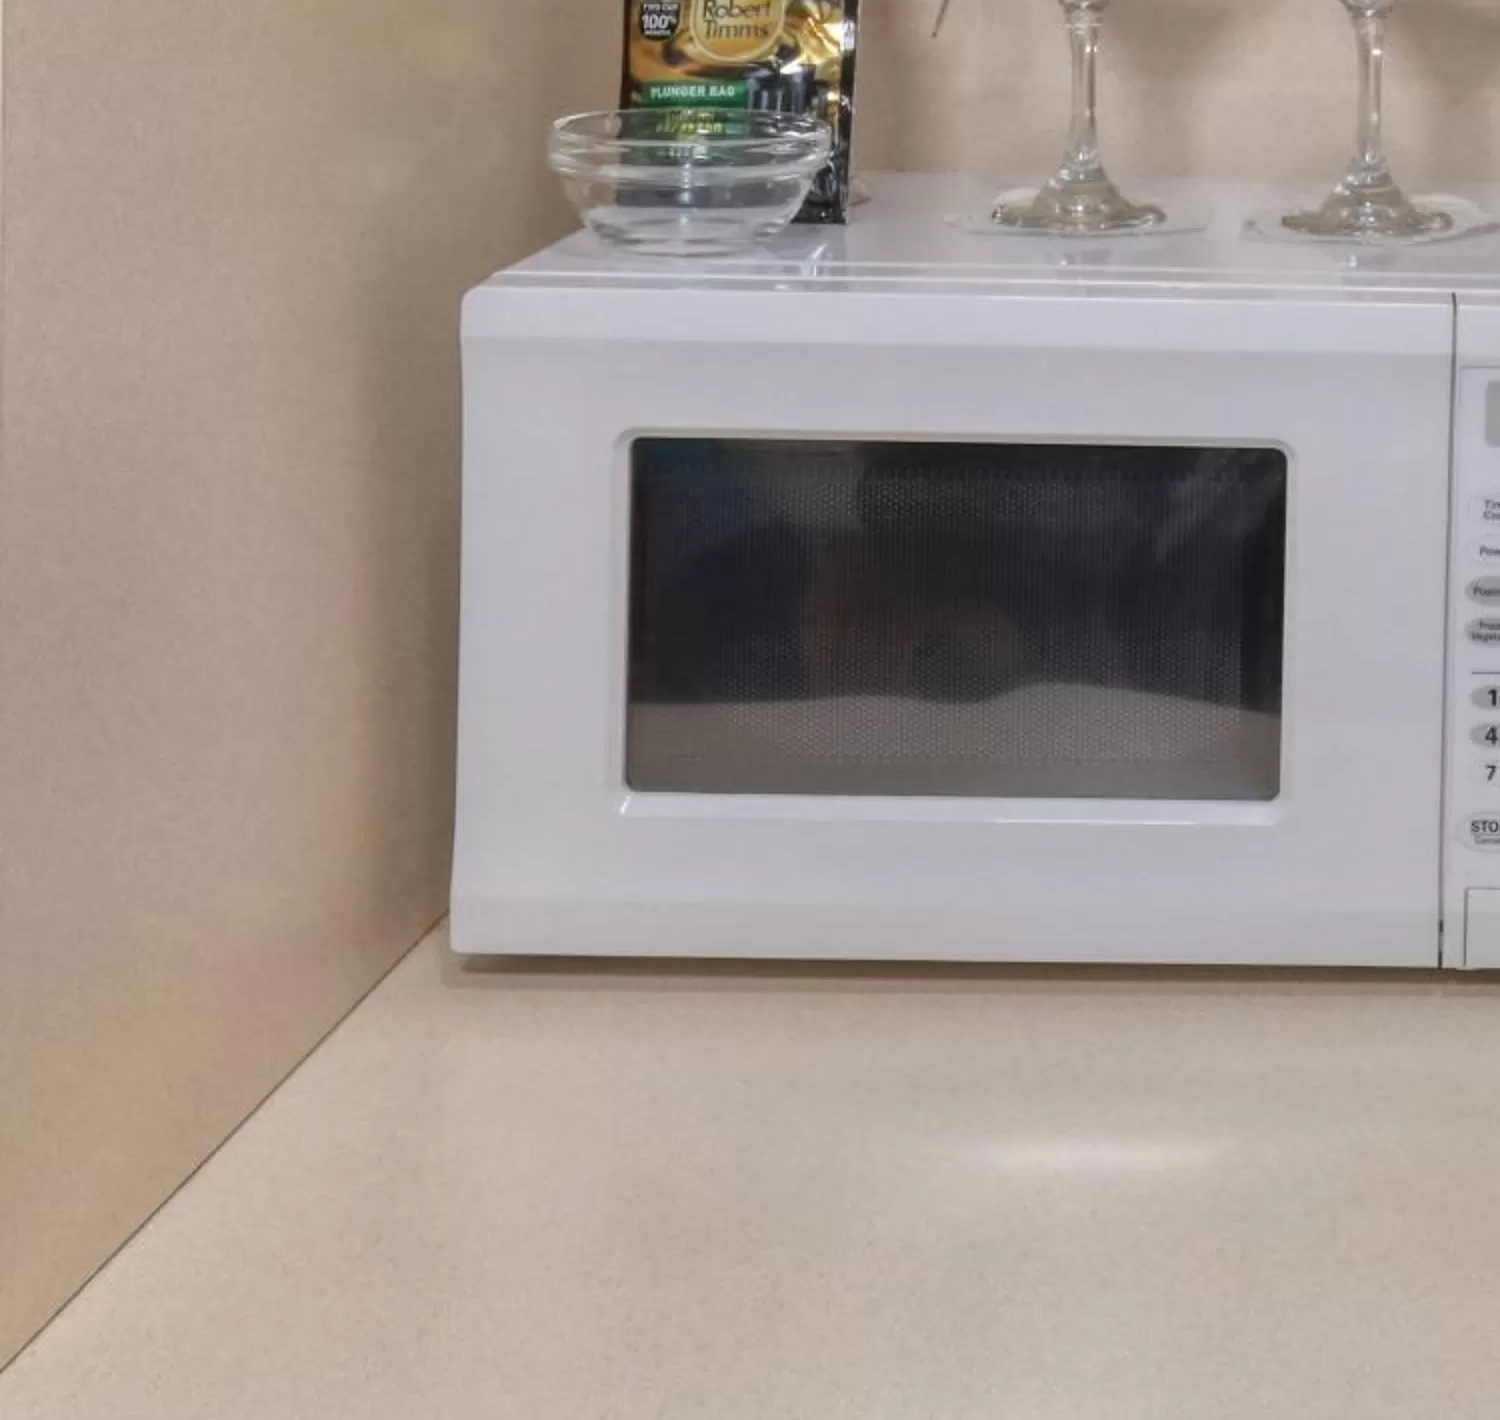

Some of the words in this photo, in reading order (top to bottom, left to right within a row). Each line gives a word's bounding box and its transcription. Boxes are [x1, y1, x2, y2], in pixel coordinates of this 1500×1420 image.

[704, 19, 770, 38] Timms
[650, 85, 707, 100] PLUNGER
[1488, 689, 1498, 707] 1
[1485, 727, 1498, 746] 4
[1485, 765, 1497, 781] 7
